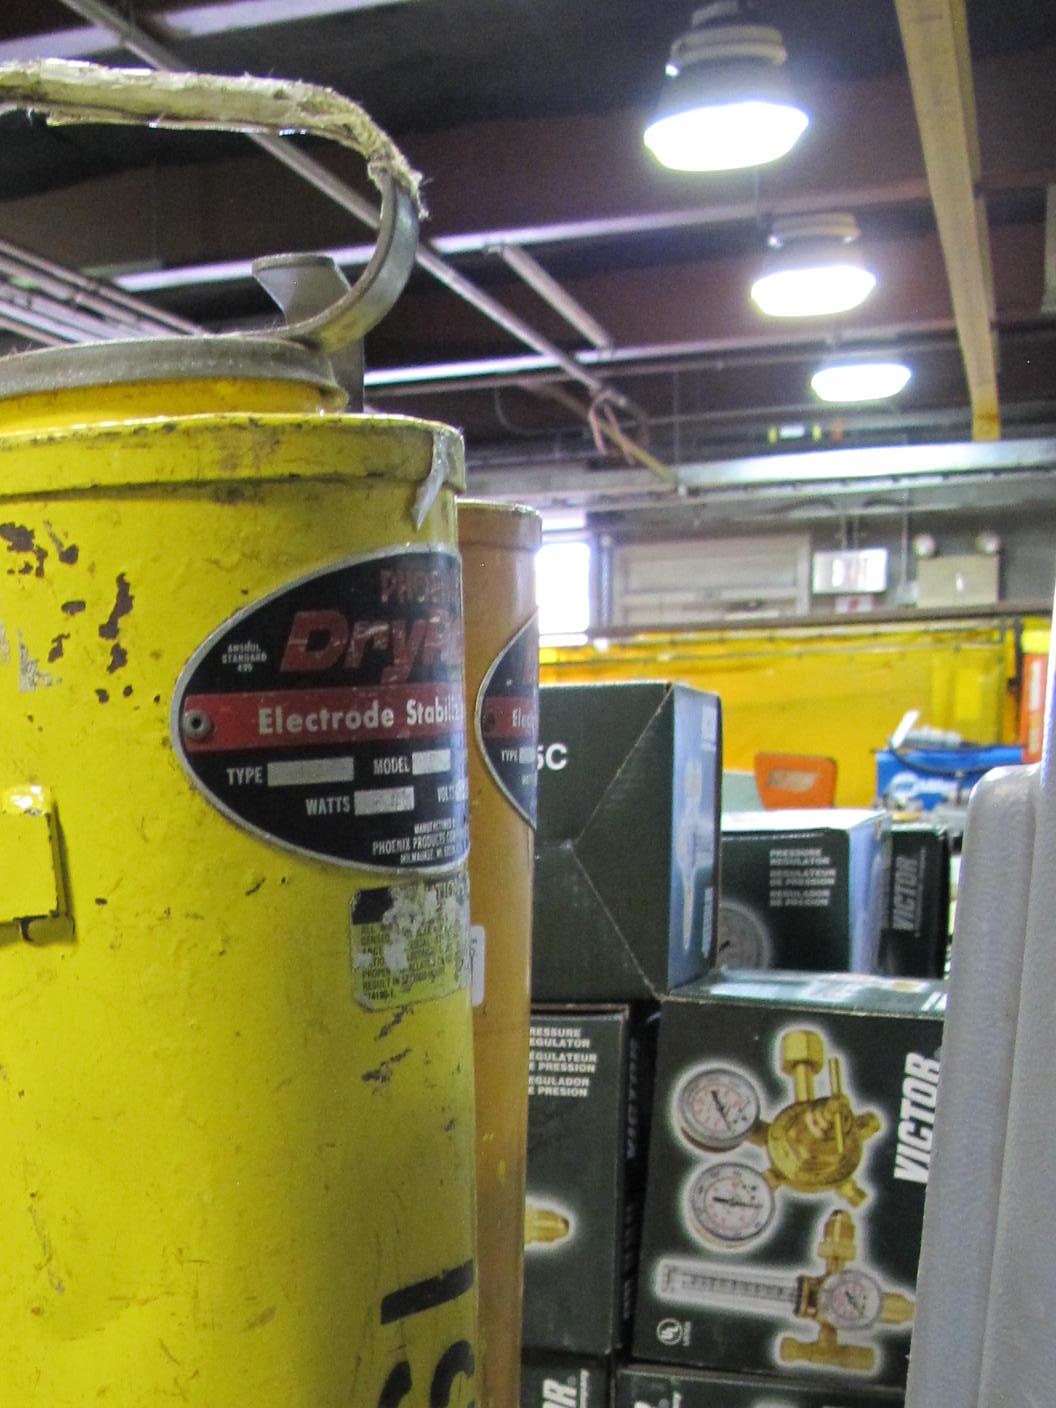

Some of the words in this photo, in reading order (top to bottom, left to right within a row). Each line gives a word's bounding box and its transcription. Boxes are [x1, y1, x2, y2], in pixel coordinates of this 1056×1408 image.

[258, 701, 394, 735] Electrode
[226, 766, 264, 786] TYPE
[373, 756, 410, 775] MODEL
[305, 795, 350, 816] WATTS
[372, 837, 410, 856] PHOENIX
[893, 855, 918, 931] VICTOR
[538, 1062, 596, 1073] PRESSION
[893, 1052, 941, 1184] VICTOR
